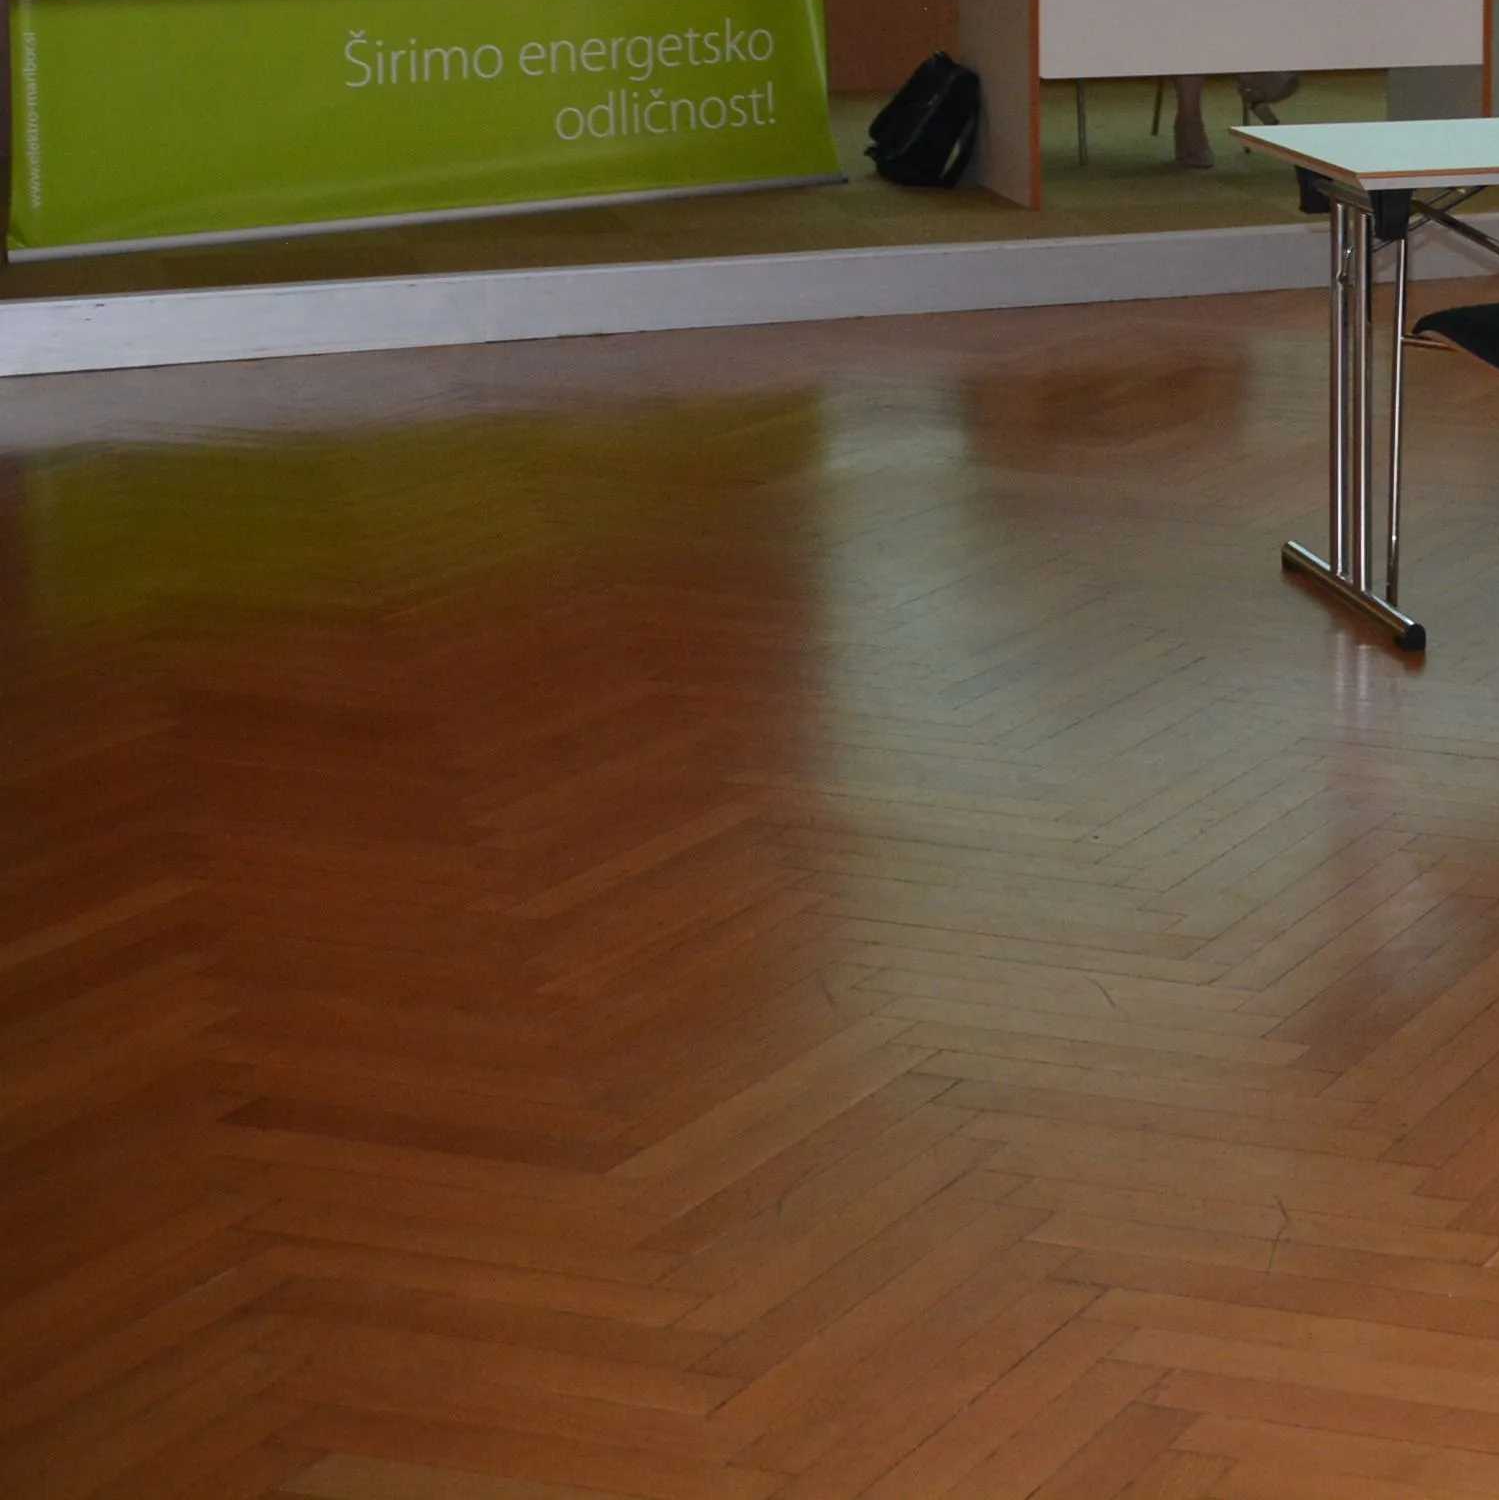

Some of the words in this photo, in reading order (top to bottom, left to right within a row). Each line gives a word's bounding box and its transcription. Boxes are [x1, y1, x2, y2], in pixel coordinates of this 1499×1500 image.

[344, 30, 503, 88] Širimo
[519, 18, 774, 82] energetsko
[23, 32, 42, 208] www.elektro-maribor.si
[555, 81, 777, 141] odličnost!
